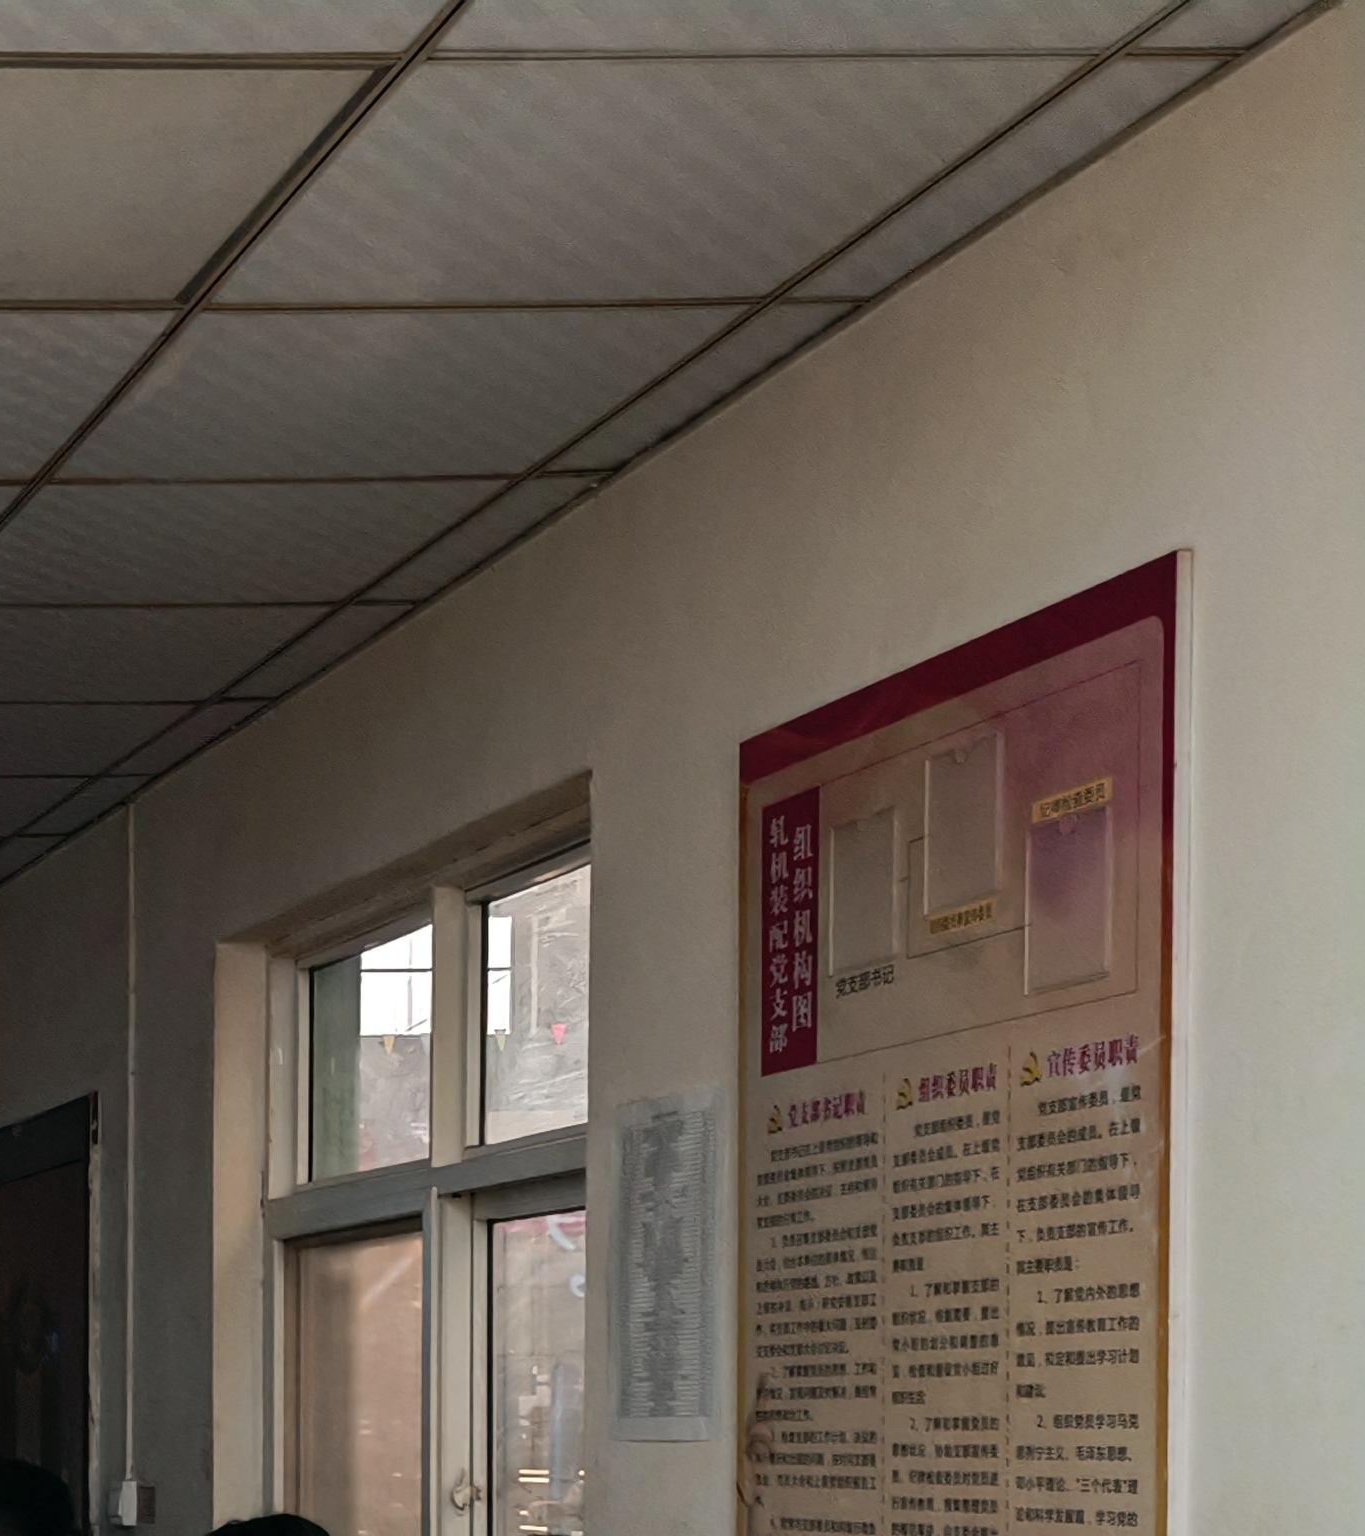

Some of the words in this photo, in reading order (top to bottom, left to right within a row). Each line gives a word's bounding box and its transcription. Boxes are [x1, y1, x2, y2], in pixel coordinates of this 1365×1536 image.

[768, 814, 789, 1054] 轧机装配党支部
[791, 823, 814, 1032] 组织机构图
[835, 963, 895, 999] 党支部书记
[1046, 1034, 1140, 1077] 宣传委员职责
[917, 1062, 998, 1102] 组织委员职责
